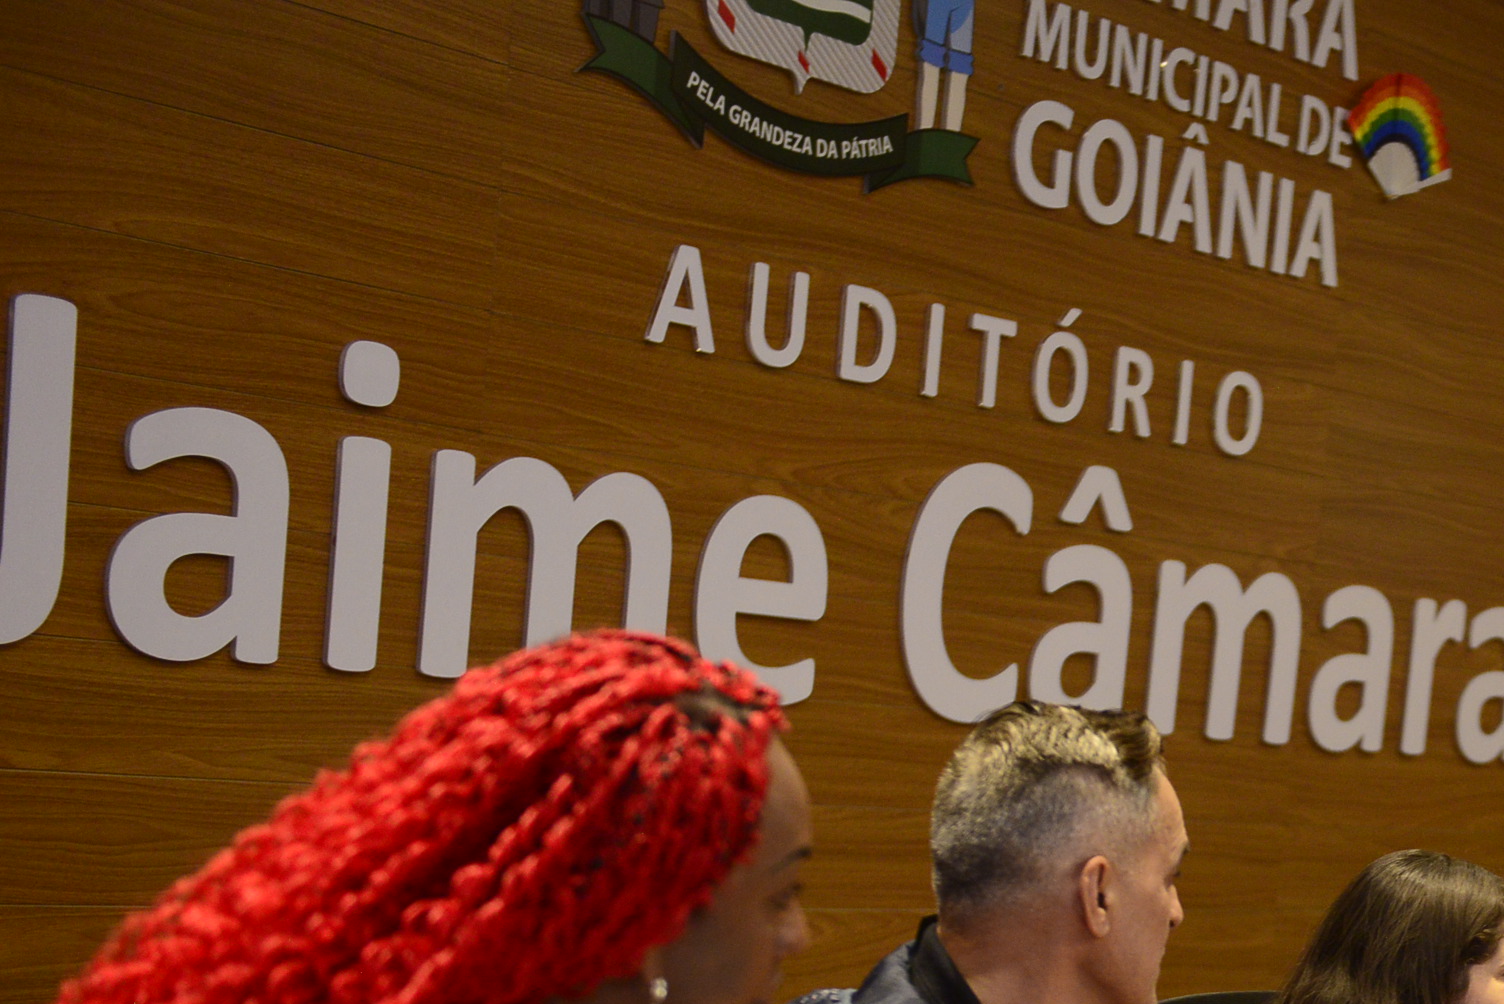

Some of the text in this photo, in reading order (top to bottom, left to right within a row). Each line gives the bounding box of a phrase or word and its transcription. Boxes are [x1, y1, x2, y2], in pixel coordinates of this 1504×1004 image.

[686, 71, 893, 160] PELA GRANDEZA DA PÁTRIA
[1020, 0, 1353, 169] MUNICIPAL DE
[1011, 99, 1337, 288] GOIÂNIA
[644, 244, 1264, 457] AUDITÓRIO
[0, 293, 829, 706] Jaime
